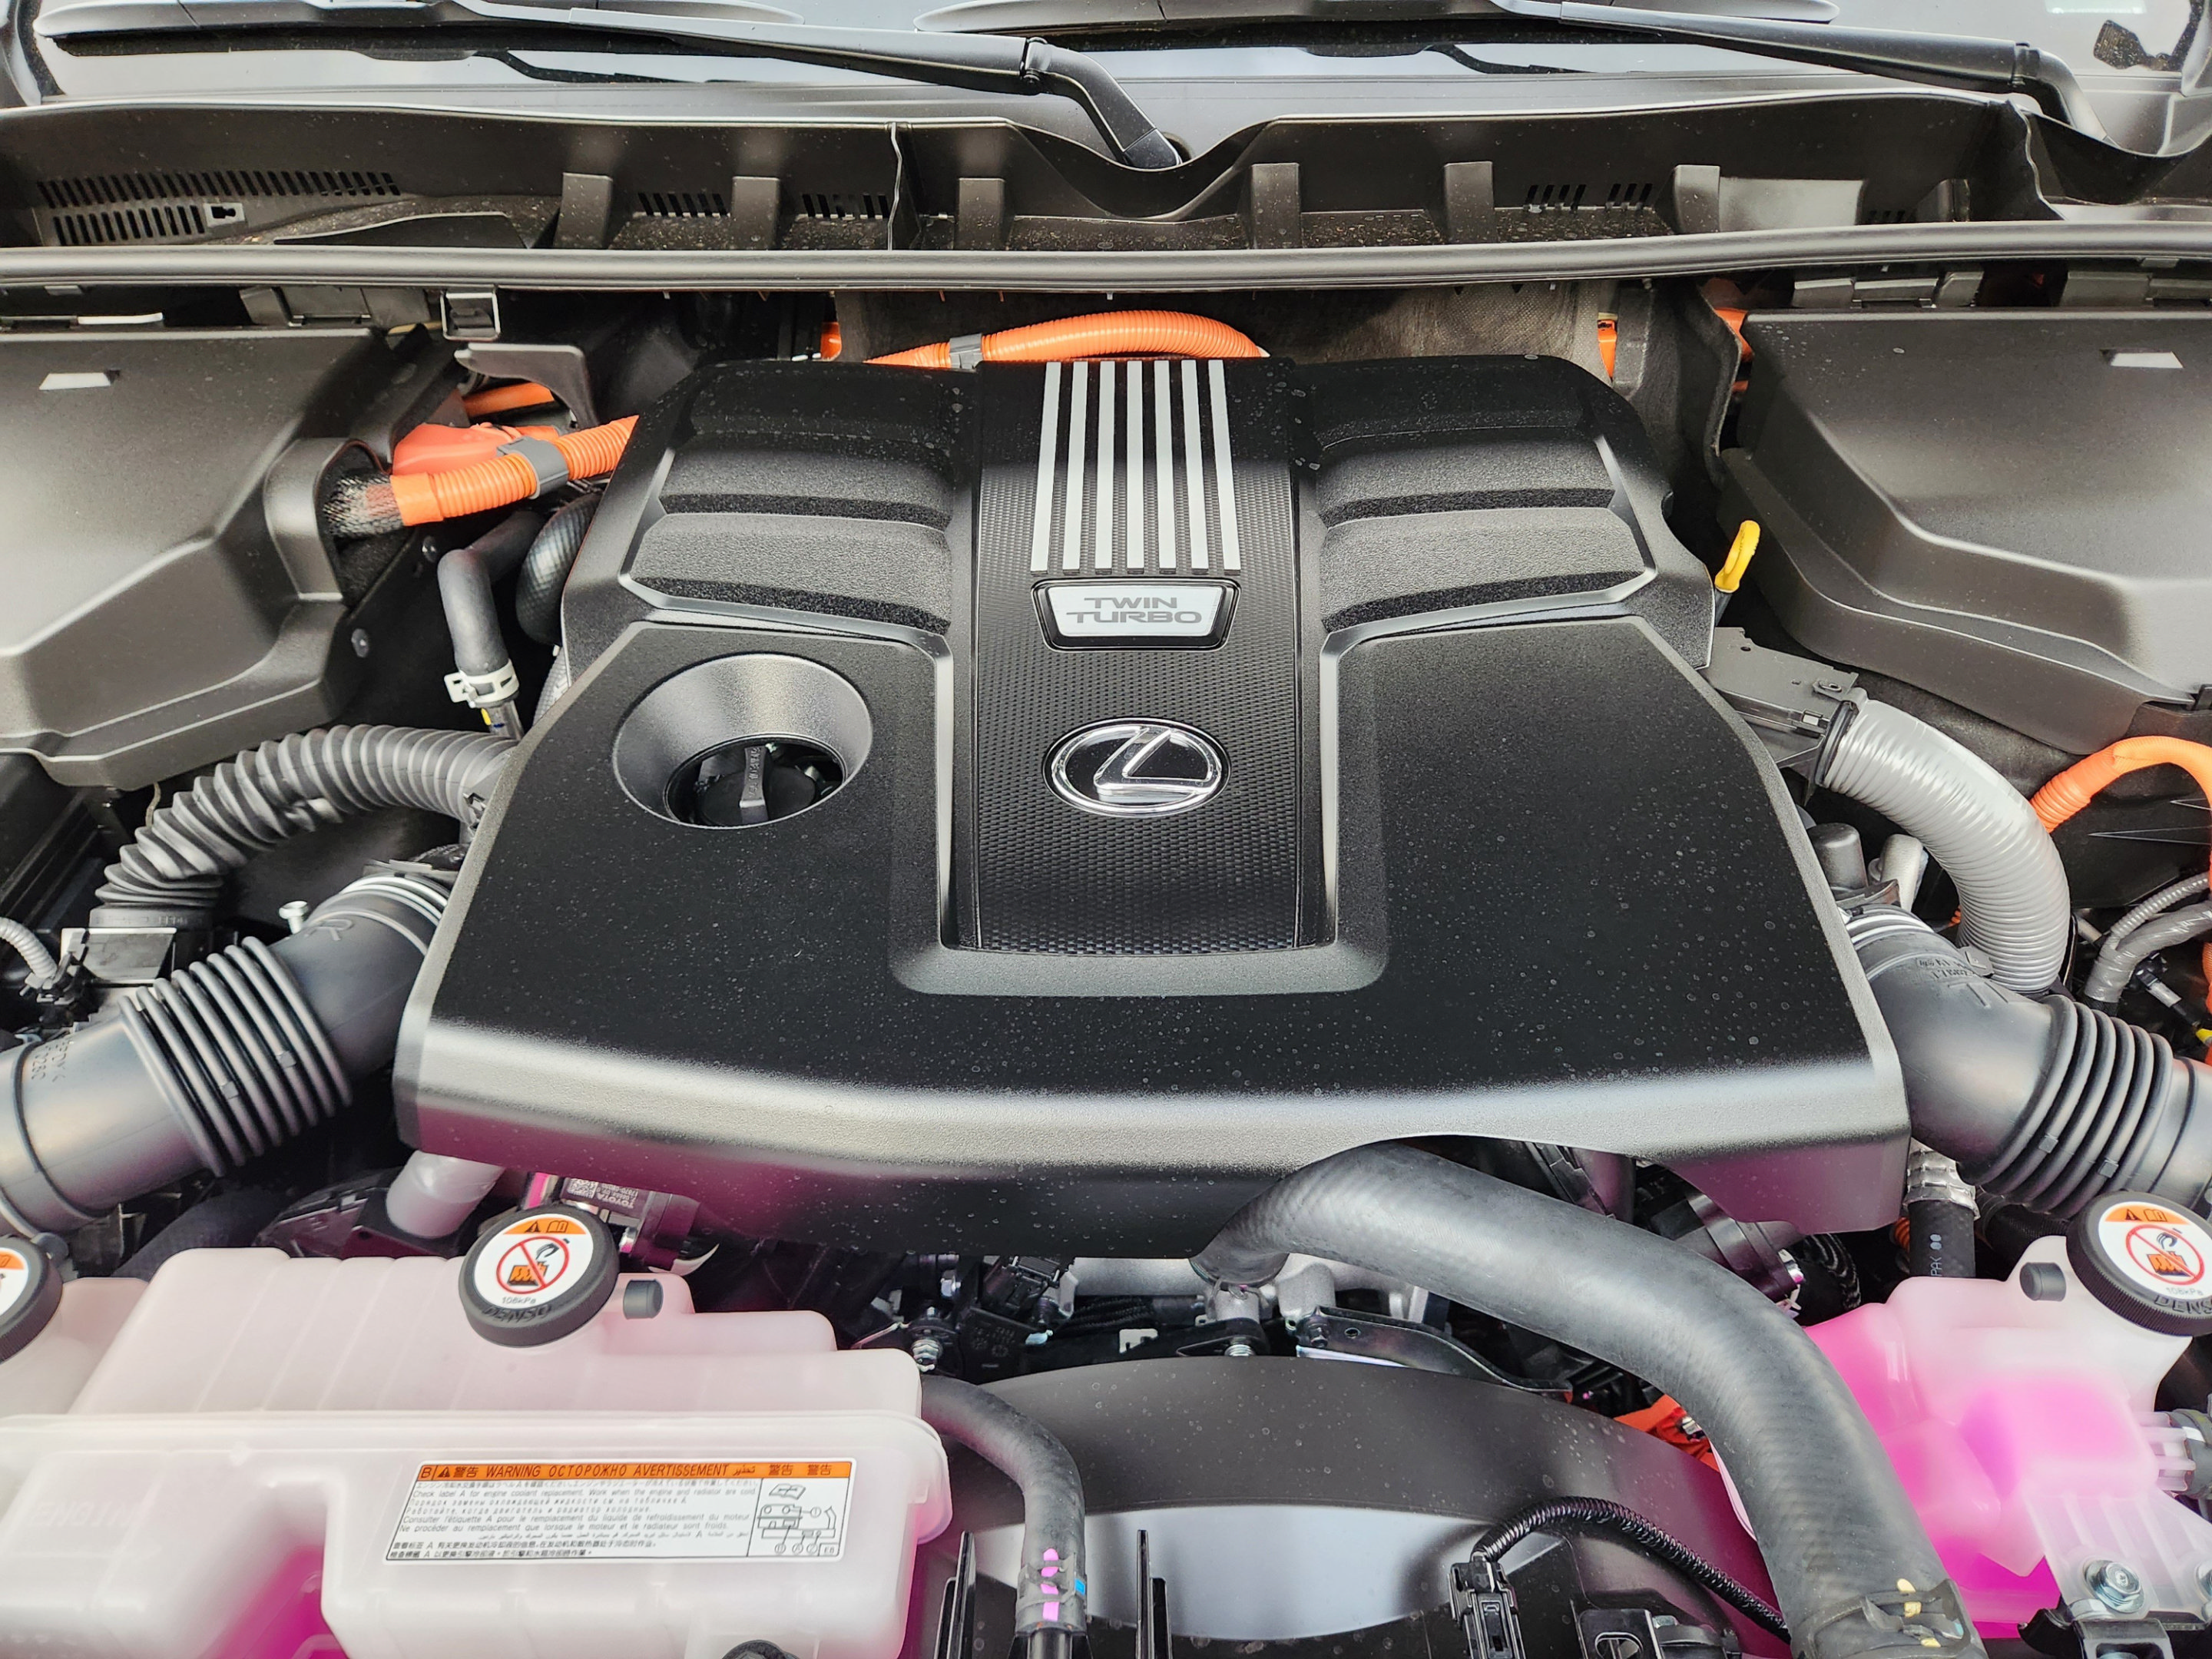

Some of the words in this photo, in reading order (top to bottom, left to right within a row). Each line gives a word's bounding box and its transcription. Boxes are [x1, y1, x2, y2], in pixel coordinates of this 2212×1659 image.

[1084, 597, 1177, 609] TWIN
[1066, 611, 1203, 624] TURBO
[597, 1192, 634, 1209] TOYOTA
[482, 1303, 553, 1323] DENSO
[421, 1467, 432, 1478] B
[485, 1465, 541, 1478] WARNING
[548, 1465, 627, 1477] ОСТОРОЖНО
[633, 1464, 730, 1476] AVERTISSEMENT
[603, 1514, 628, 1522] liquide
[414, 1524, 449, 1533] procéder
[468, 1524, 521, 1532] remplacement
[544, 1523, 573, 1532] lorsque
